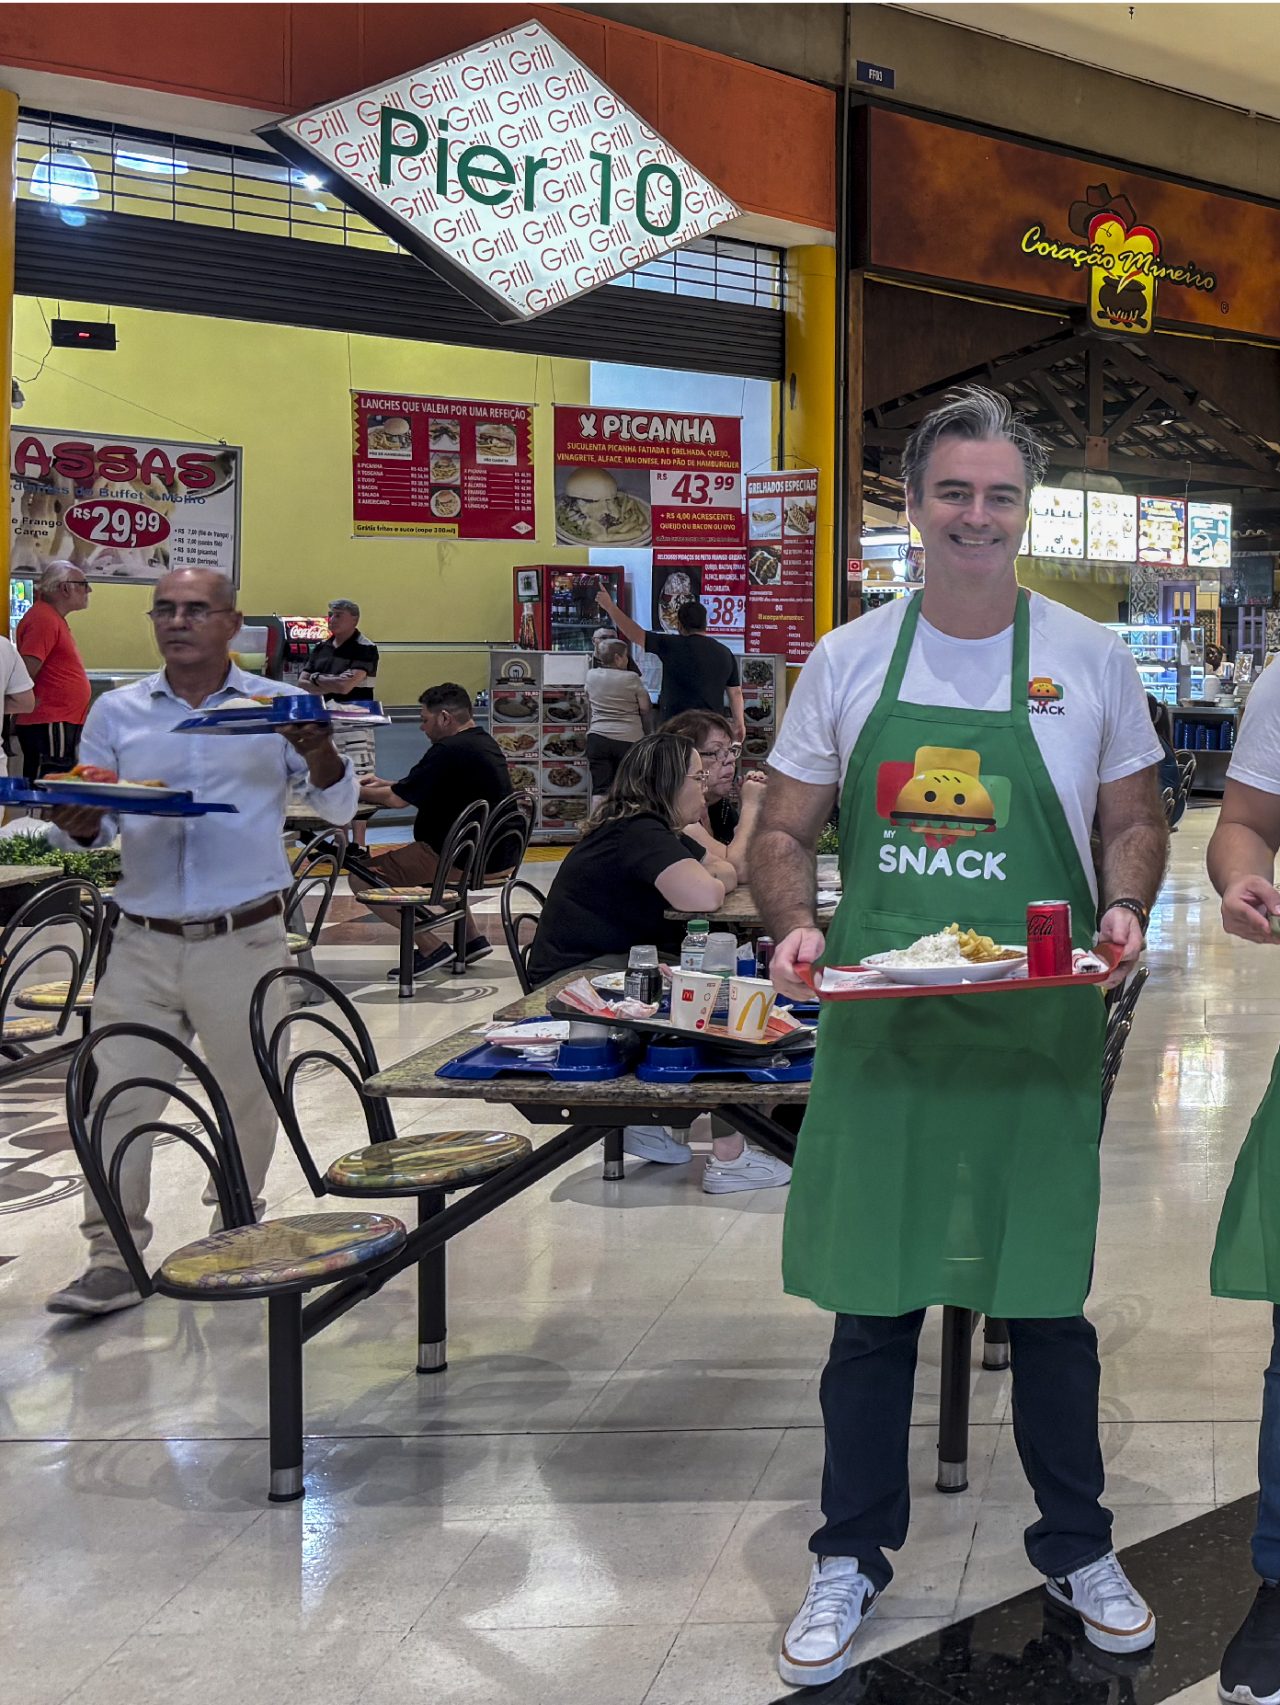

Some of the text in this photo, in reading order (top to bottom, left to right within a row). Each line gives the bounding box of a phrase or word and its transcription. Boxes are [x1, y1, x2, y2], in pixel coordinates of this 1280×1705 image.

[410, 74, 458, 108] Grill
[461, 58, 508, 91] Grill
[509, 44, 554, 75] Grill
[447, 99, 493, 131] Grill
[497, 83, 543, 115] Grill
[545, 68, 589, 100] Grill
[498, 116, 543, 148] Grill
[548, 101, 592, 132] Grill
[590, 123, 633, 154] Grill
[379, 105, 682, 236] Pier 10
[434, 208, 482, 242] Grill
[543, 171, 587, 202] Grill
[472, 228, 518, 262] Grill
[523, 211, 567, 244] Grill
[541, 238, 584, 271] Grill
[589, 220, 632, 252] Grill
[1021, 226, 1216, 290] Coração Mineiro
[526, 278, 568, 312] Grill
[574, 256, 616, 289] Grill
[620, 237, 658, 268] Grill
[361, 398, 526, 422] LANCHES QUE VALEM POR UMA REFEIÇÃO
[580, 412, 716, 444] X PICANHA
[557, 453, 596, 463] VINAGRETE,
[598, 455, 623, 464] ALFACE,
[625, 456, 659, 465] MAIONESE,
[672, 457, 686, 466] PÃO
[567, 443, 606, 452] SUCULENTA
[608, 444, 637, 453] PICANHA
[638, 446, 664, 454] FATIADA
[707, 450, 730, 458] QUEIJO,
[100, 487, 144, 500] Buffet
[162, 492, 206, 506] Molho
[671, 474, 735, 505] 43,99
[748, 479, 817, 494] GRELHADOS ESPECIAIS
[14, 528, 49, 536] Carne
[22, 517, 63, 528] Frango
[676, 513, 690, 521] 4,00
[692, 513, 735, 522] ACRESCENTE:
[883, 829, 896, 840] MY
[878, 844, 1006, 882] SNACK
